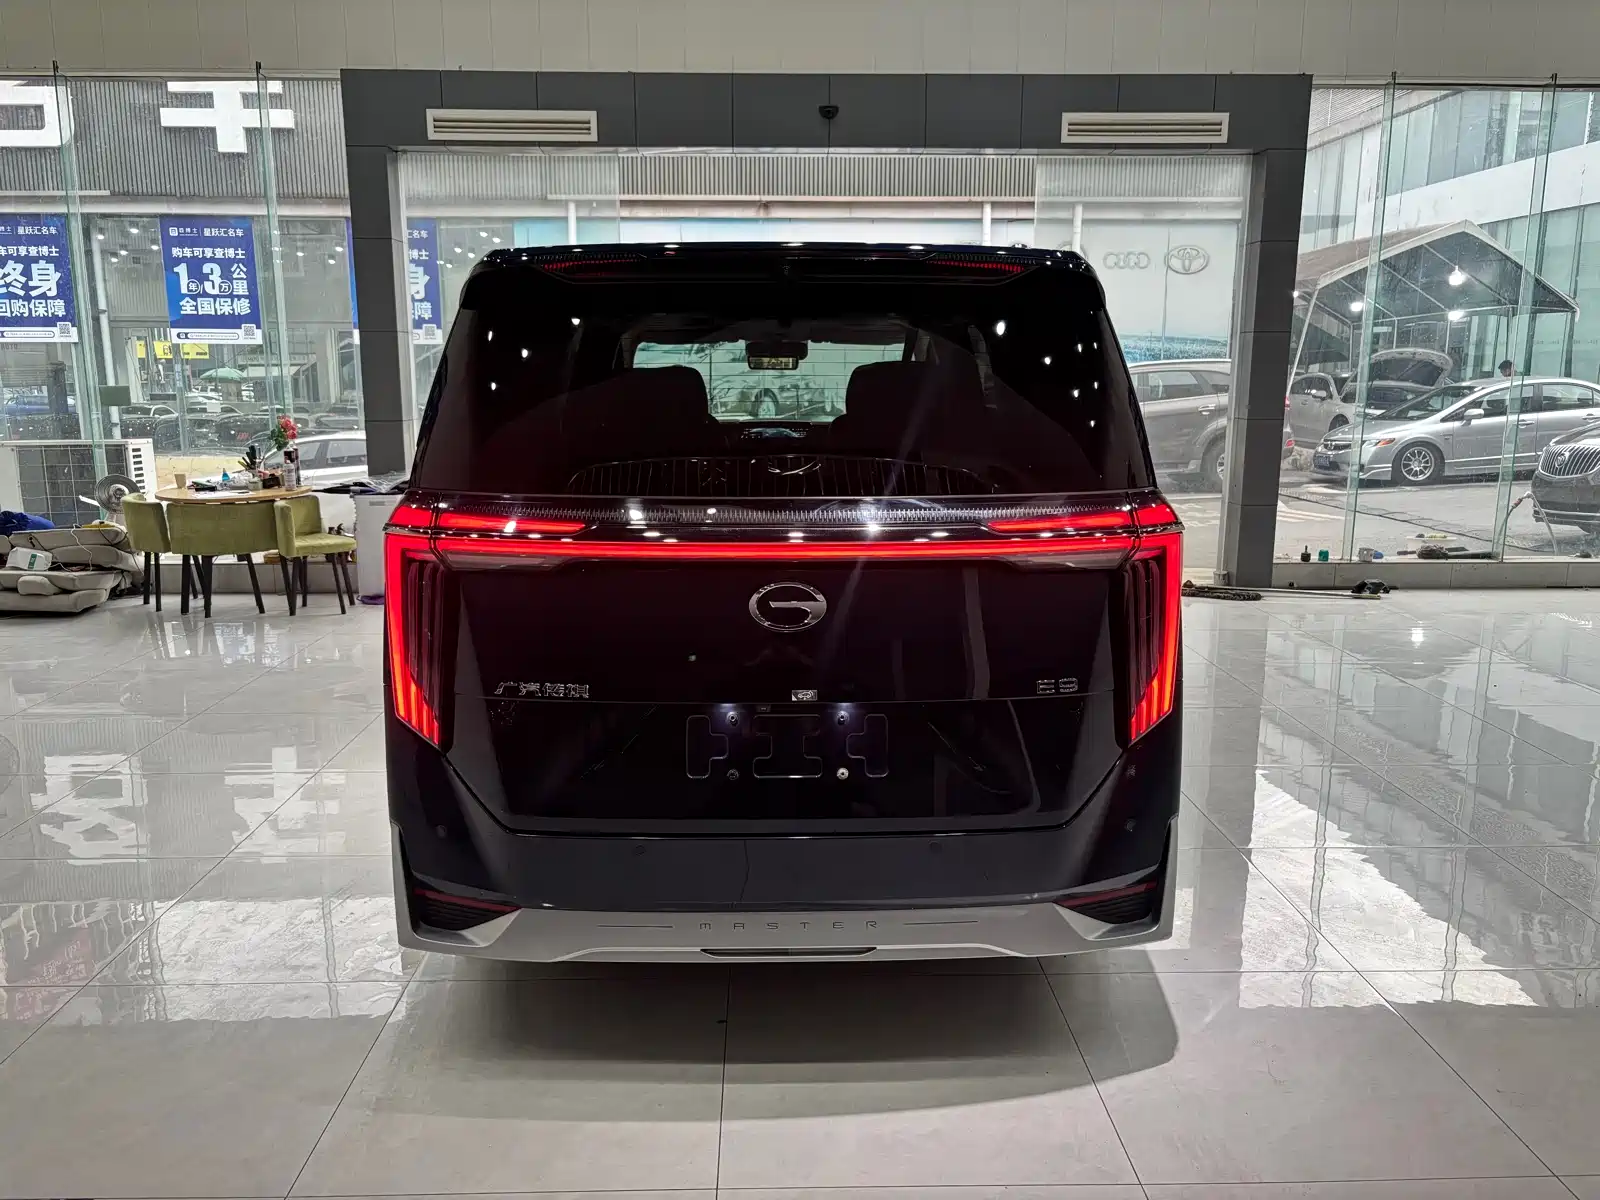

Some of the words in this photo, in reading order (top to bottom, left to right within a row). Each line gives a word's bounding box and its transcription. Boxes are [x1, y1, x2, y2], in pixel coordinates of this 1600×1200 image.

[17, 226, 58, 236] 星跃汇名车
[203, 228, 244, 237] 星跃汇名车
[171, 247, 246, 259] 购车可享查博士
[0, 260, 61, 297] 终身
[0, 299, 67, 318] 回购保障
[180, 297, 252, 316] 全国保修
[411, 301, 433, 320] 障
[494, 681, 590, 698] 广汽传祺
[699, 920, 877, 932] MASTER
